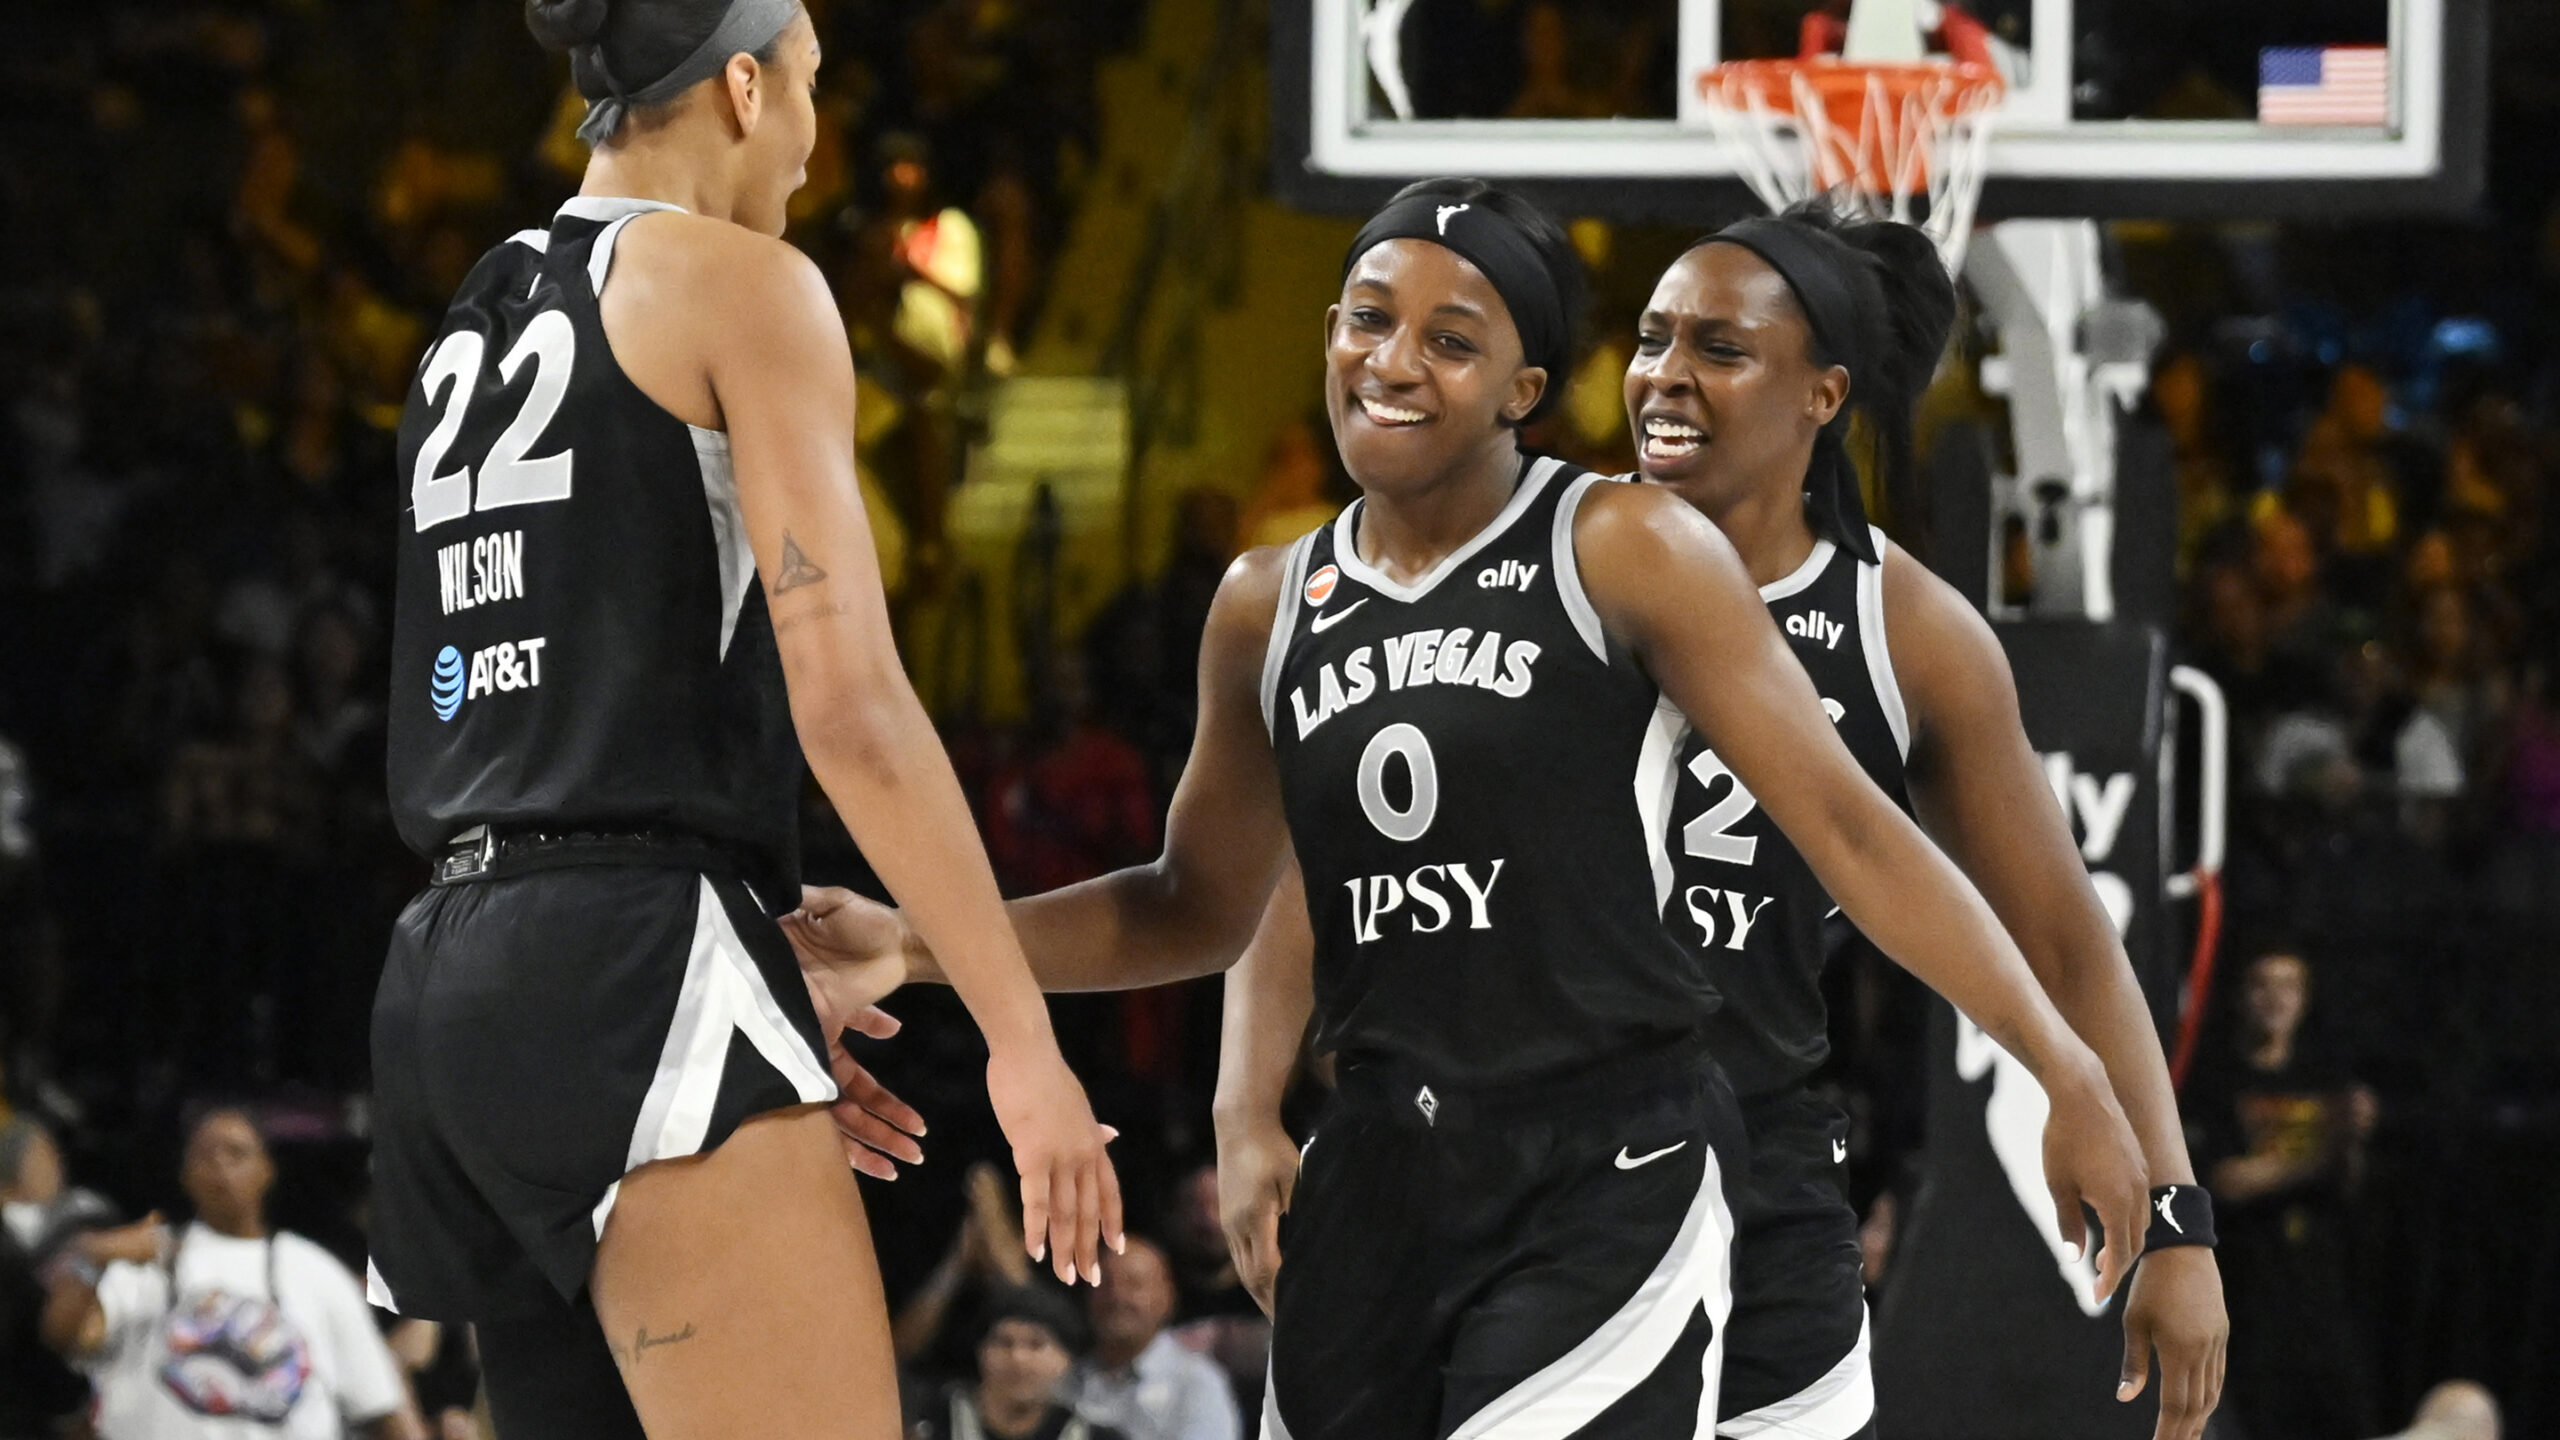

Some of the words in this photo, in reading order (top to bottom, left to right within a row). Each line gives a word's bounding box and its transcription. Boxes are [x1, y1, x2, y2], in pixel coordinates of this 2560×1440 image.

[411, 309, 576, 533] 22
[436, 529, 524, 616] WILSON
[1476, 559, 1540, 593] ally
[466, 636, 547, 701] AT&T
[1785, 609, 1845, 651] ally
[1289, 645, 1377, 741] LAS
[1382, 627, 1542, 698] VEGAS
[1356, 722, 1439, 842] 0
[2036, 750, 2138, 864] ly
[1684, 884, 1775, 951] SY
